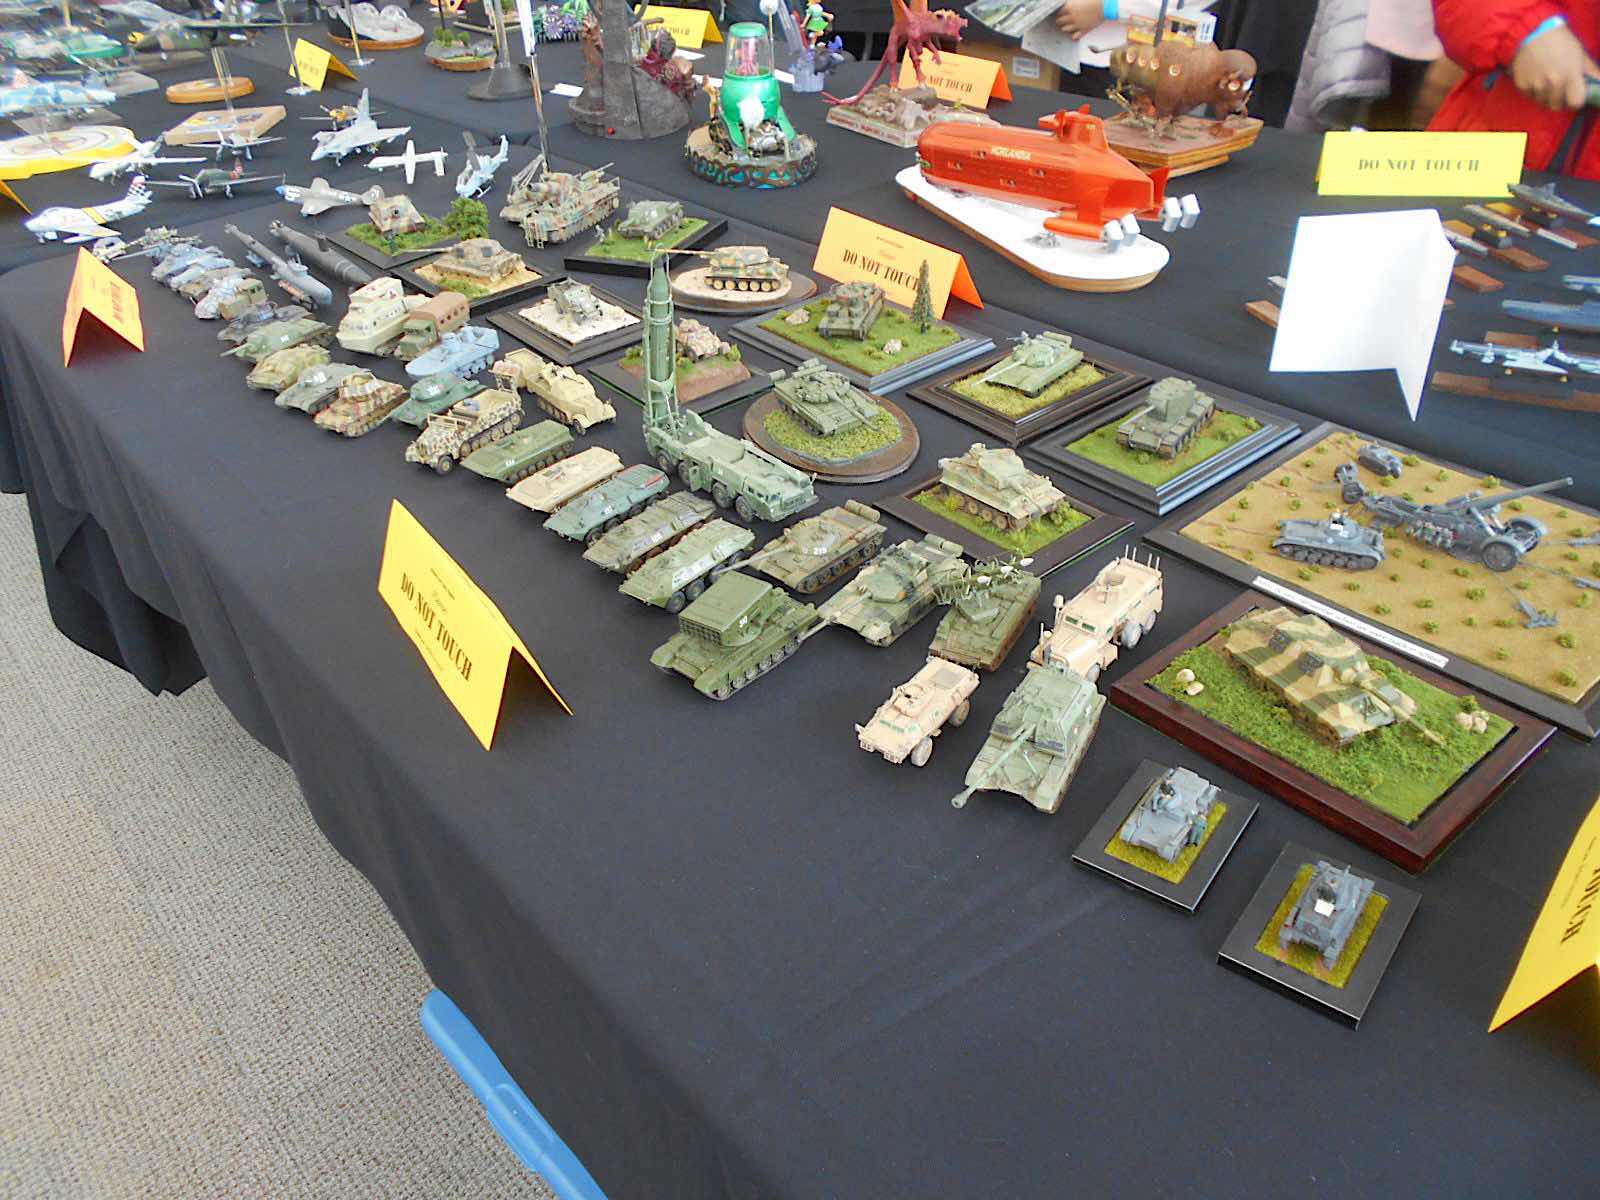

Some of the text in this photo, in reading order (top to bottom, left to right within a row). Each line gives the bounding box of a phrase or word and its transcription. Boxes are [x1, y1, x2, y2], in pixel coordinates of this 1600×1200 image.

[945, 79, 973, 92] TOUCH
[1358, 159, 1480, 171] DO NOT TOUCH
[842, 249, 858, 265] DO
[858, 255, 881, 275] NOT
[400, 571, 414, 601] DO
[414, 591, 436, 631] NOT
[436, 619, 472, 682] TOUCH
